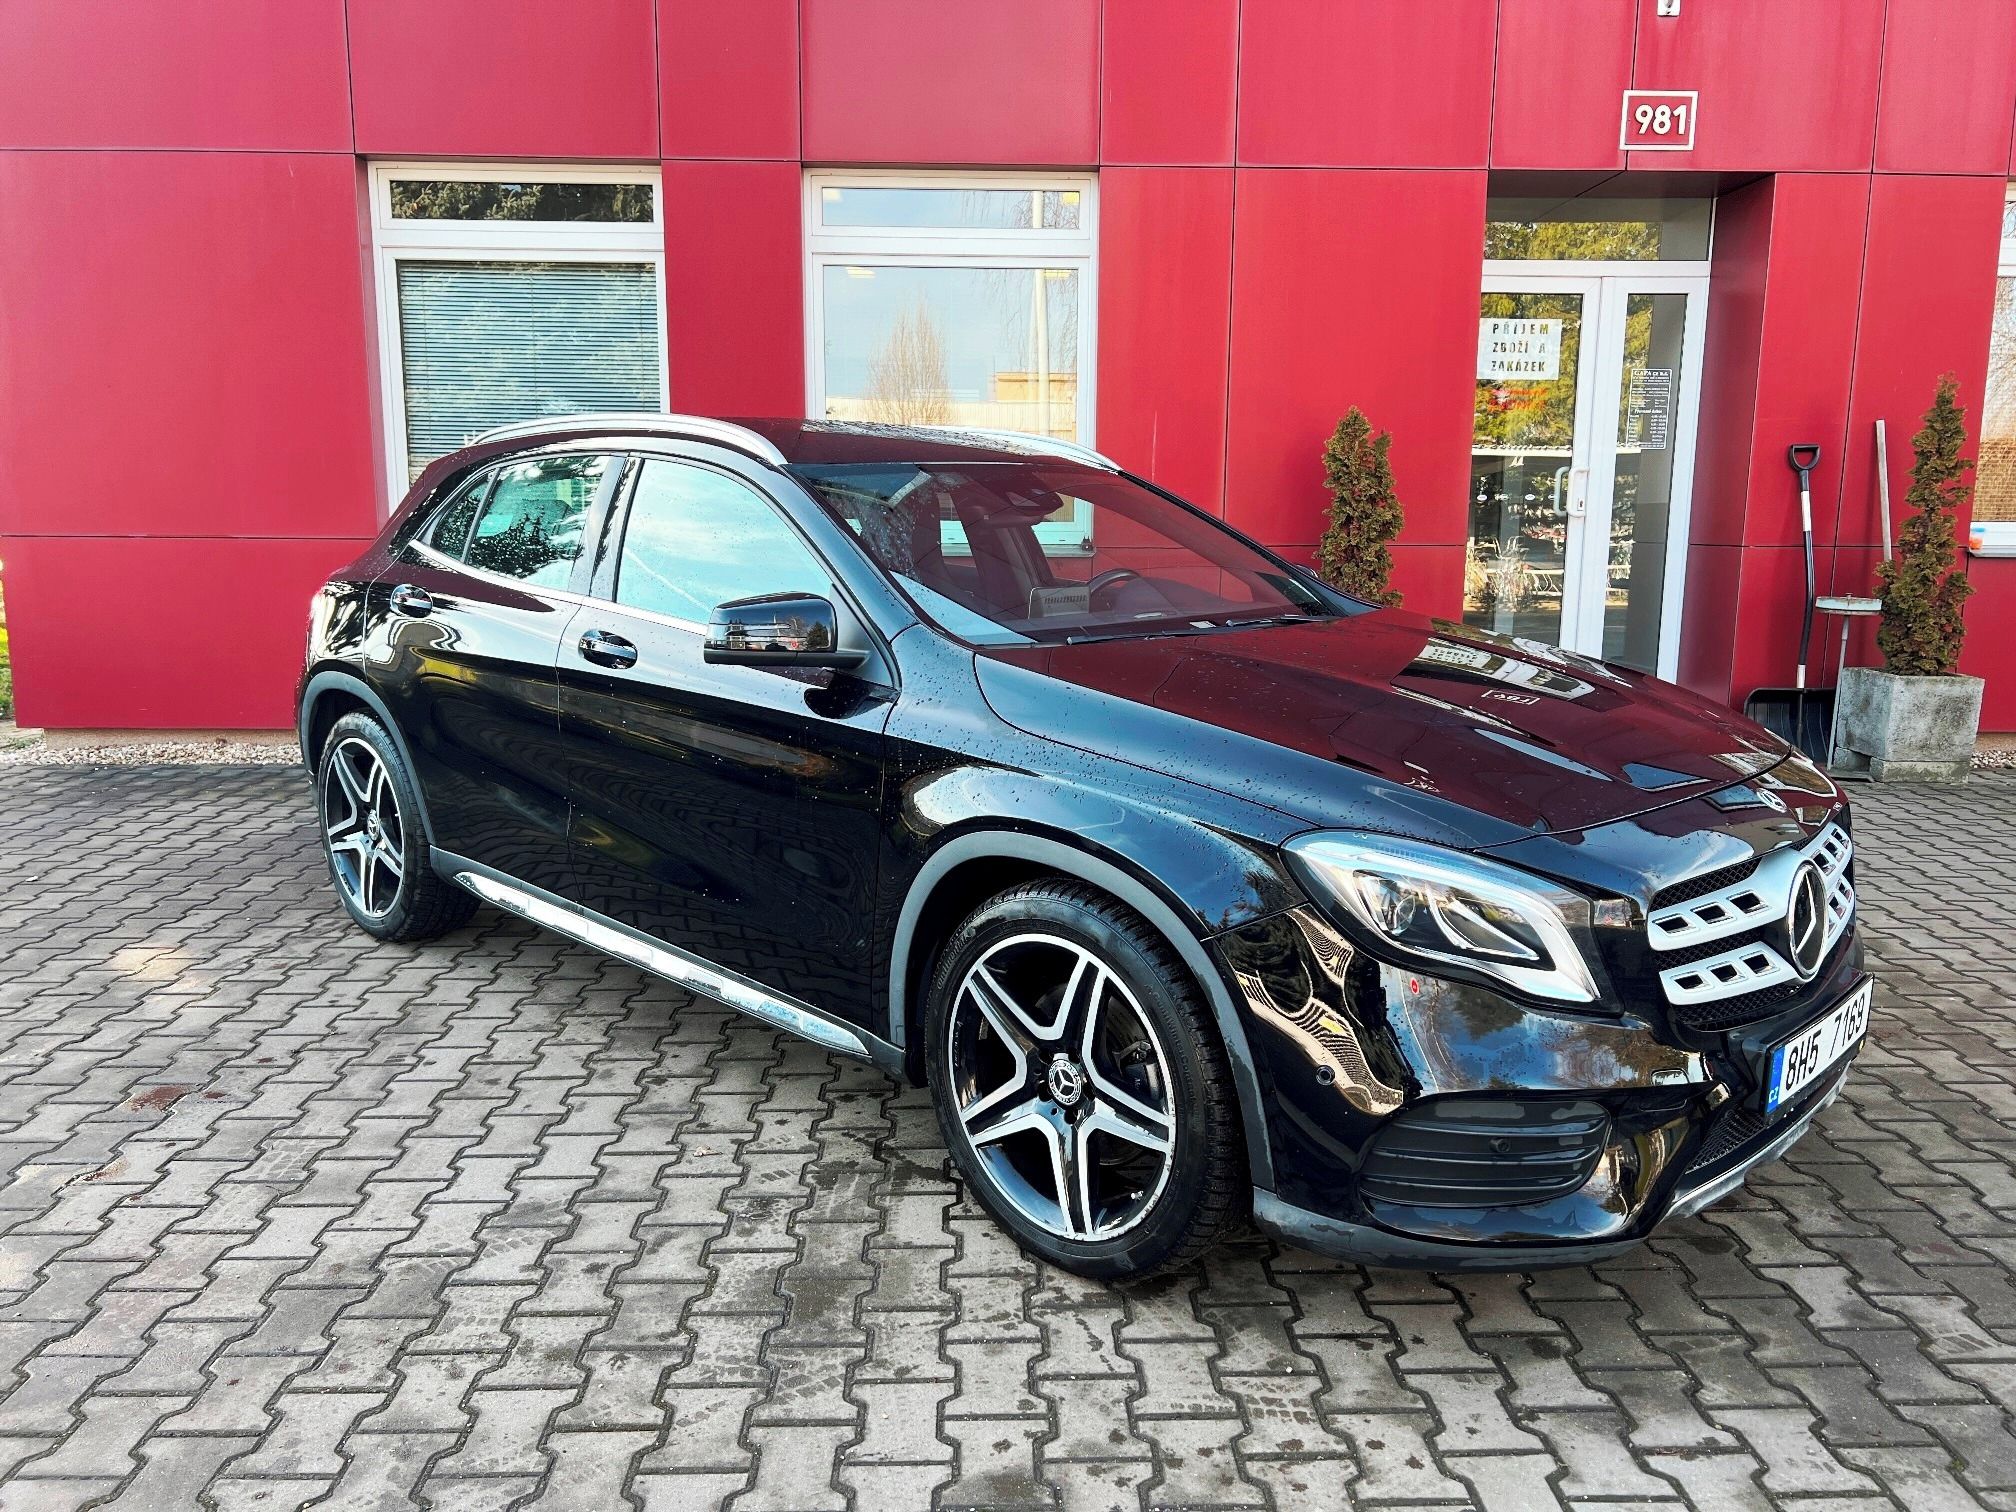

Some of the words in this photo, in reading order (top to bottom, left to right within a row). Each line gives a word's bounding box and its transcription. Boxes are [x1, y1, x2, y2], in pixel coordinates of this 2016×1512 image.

[1635, 104, 1687, 135] 981
[1492, 321, 1549, 335] PŘÍJEM
[1492, 341, 1529, 353] ZBOŽÍ
[1538, 343, 1545, 353] A
[1491, 359, 1545, 372] ZAKÁZEK
[1785, 1028, 1822, 1091] 8H5
[1829, 992, 1866, 1059] 7169
[1768, 1086, 1779, 1104] CZ
